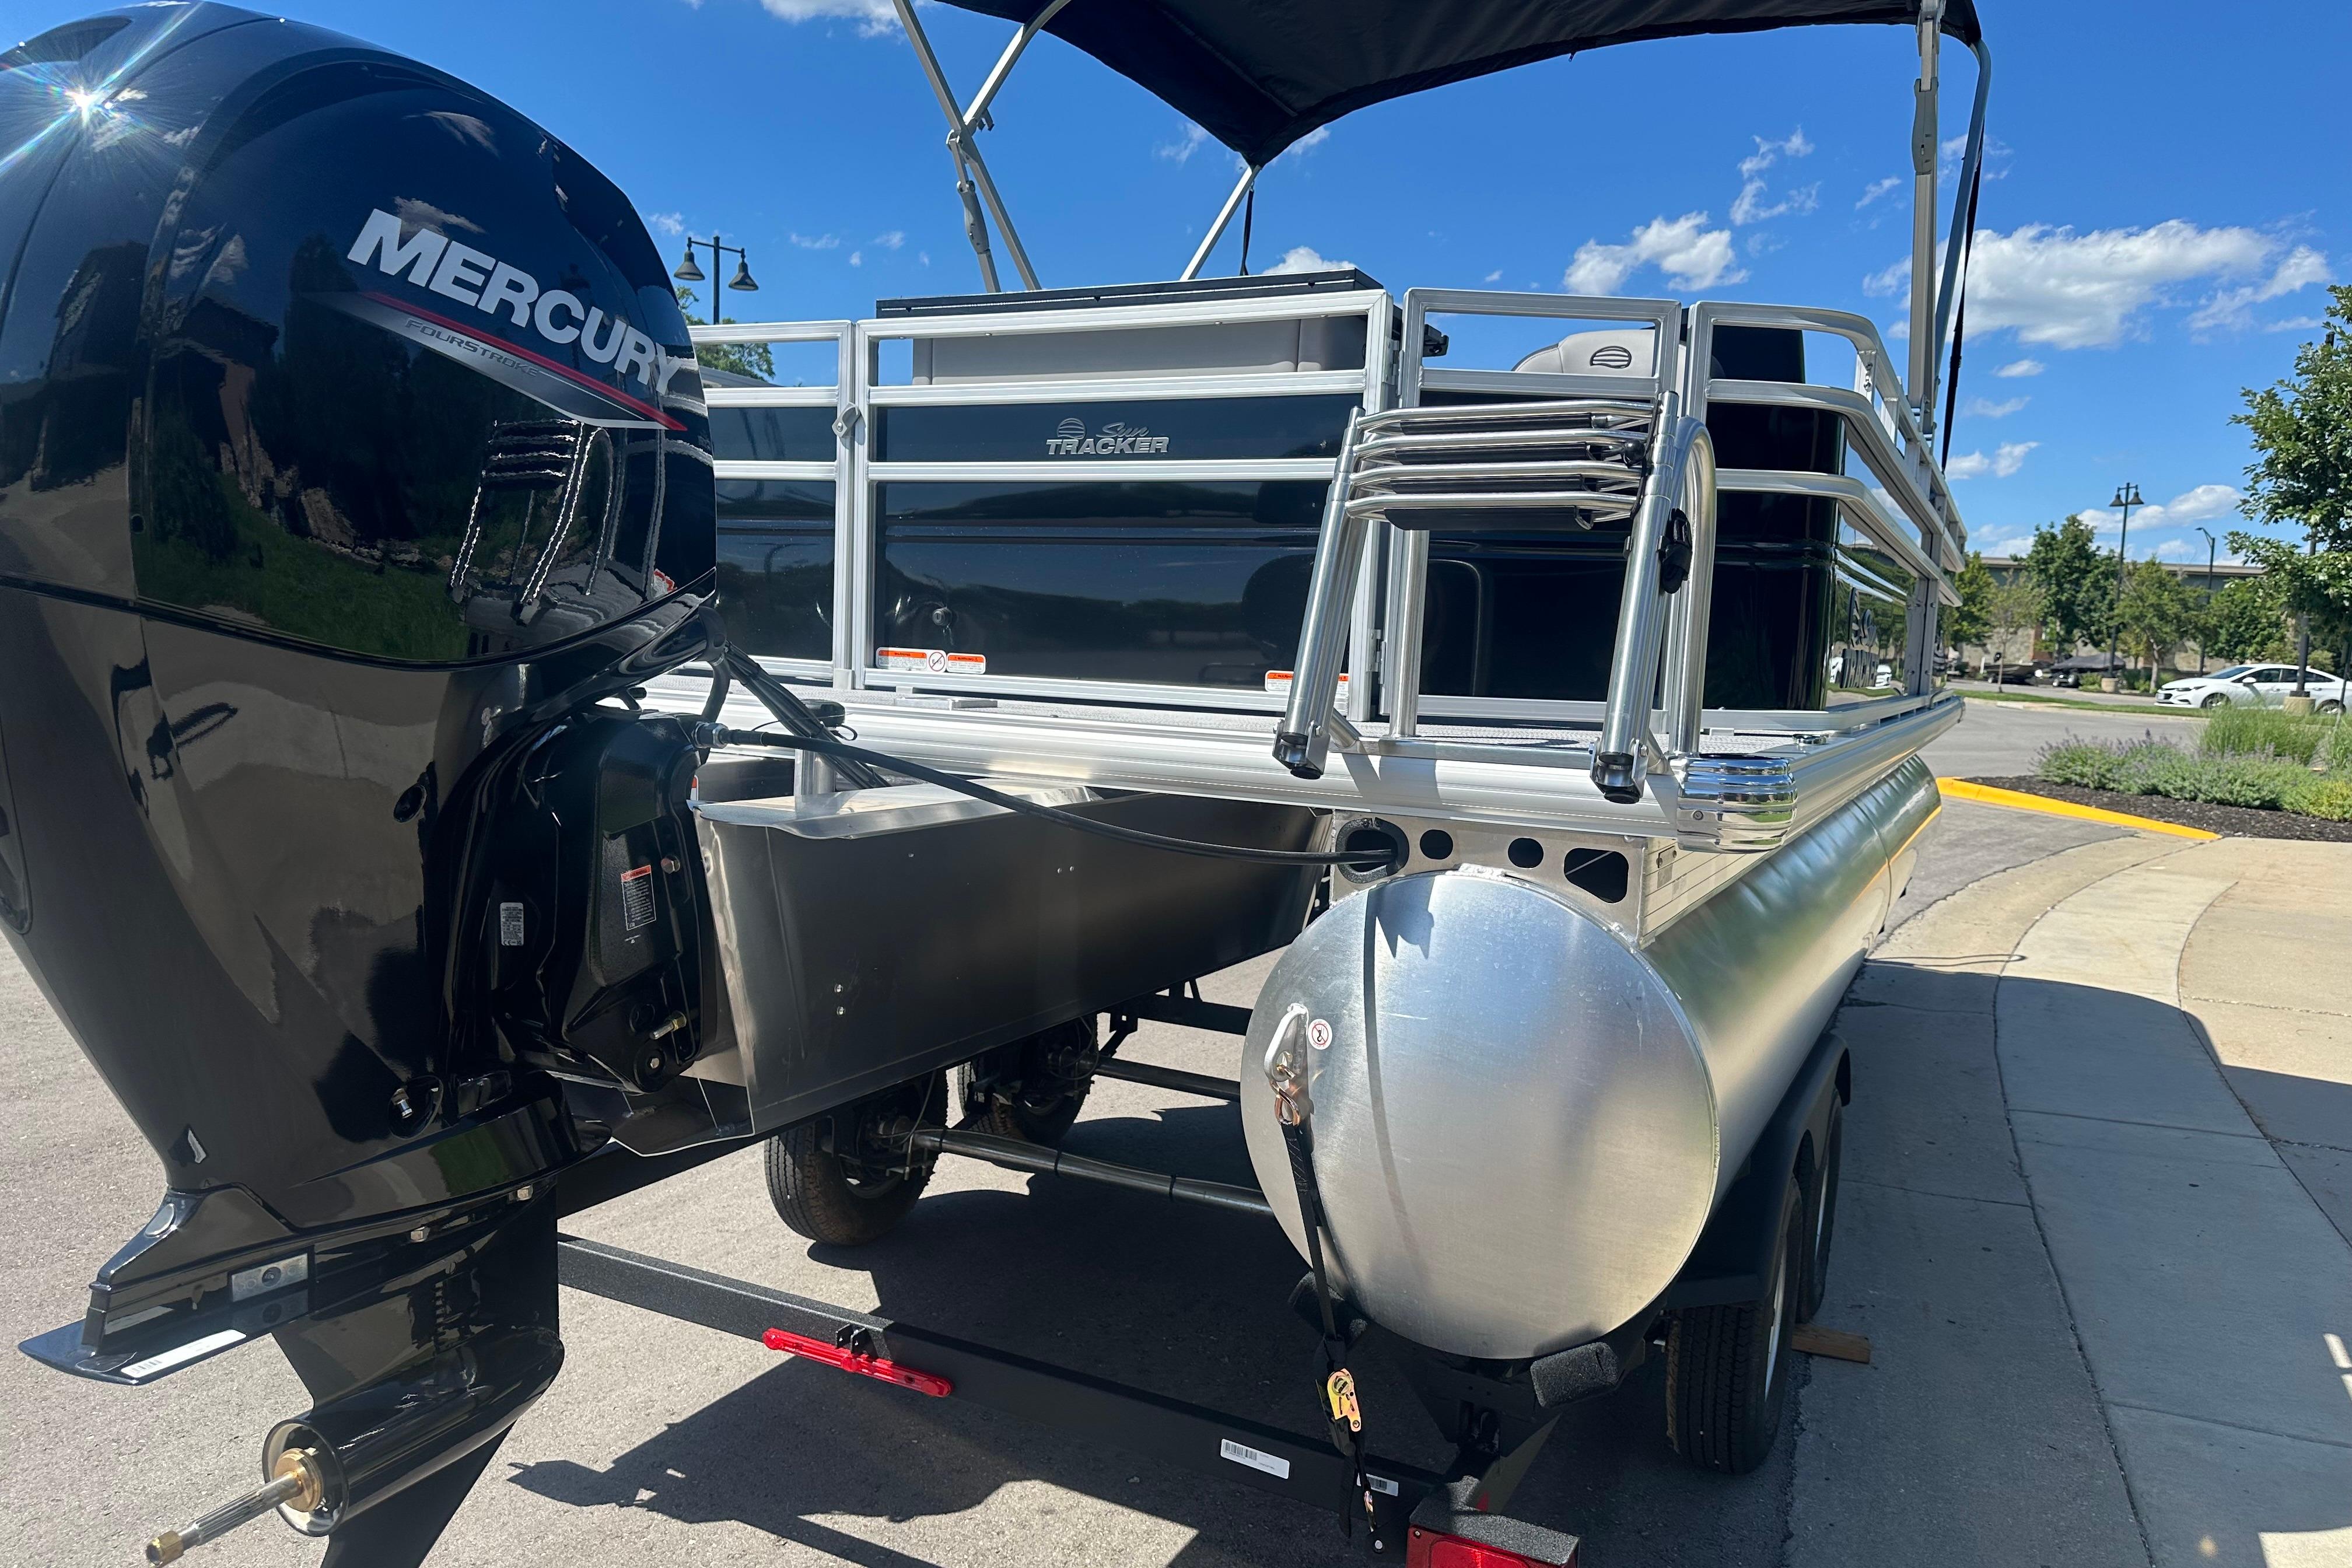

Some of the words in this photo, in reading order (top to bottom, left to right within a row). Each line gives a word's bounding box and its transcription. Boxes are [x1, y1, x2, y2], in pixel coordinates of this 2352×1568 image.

[347, 208, 684, 396] MERCURY
[405, 318, 540, 378] FOURSTROKE
[1046, 437, 1170, 455] TRACKER
[1096, 422, 1149, 438] Sun
